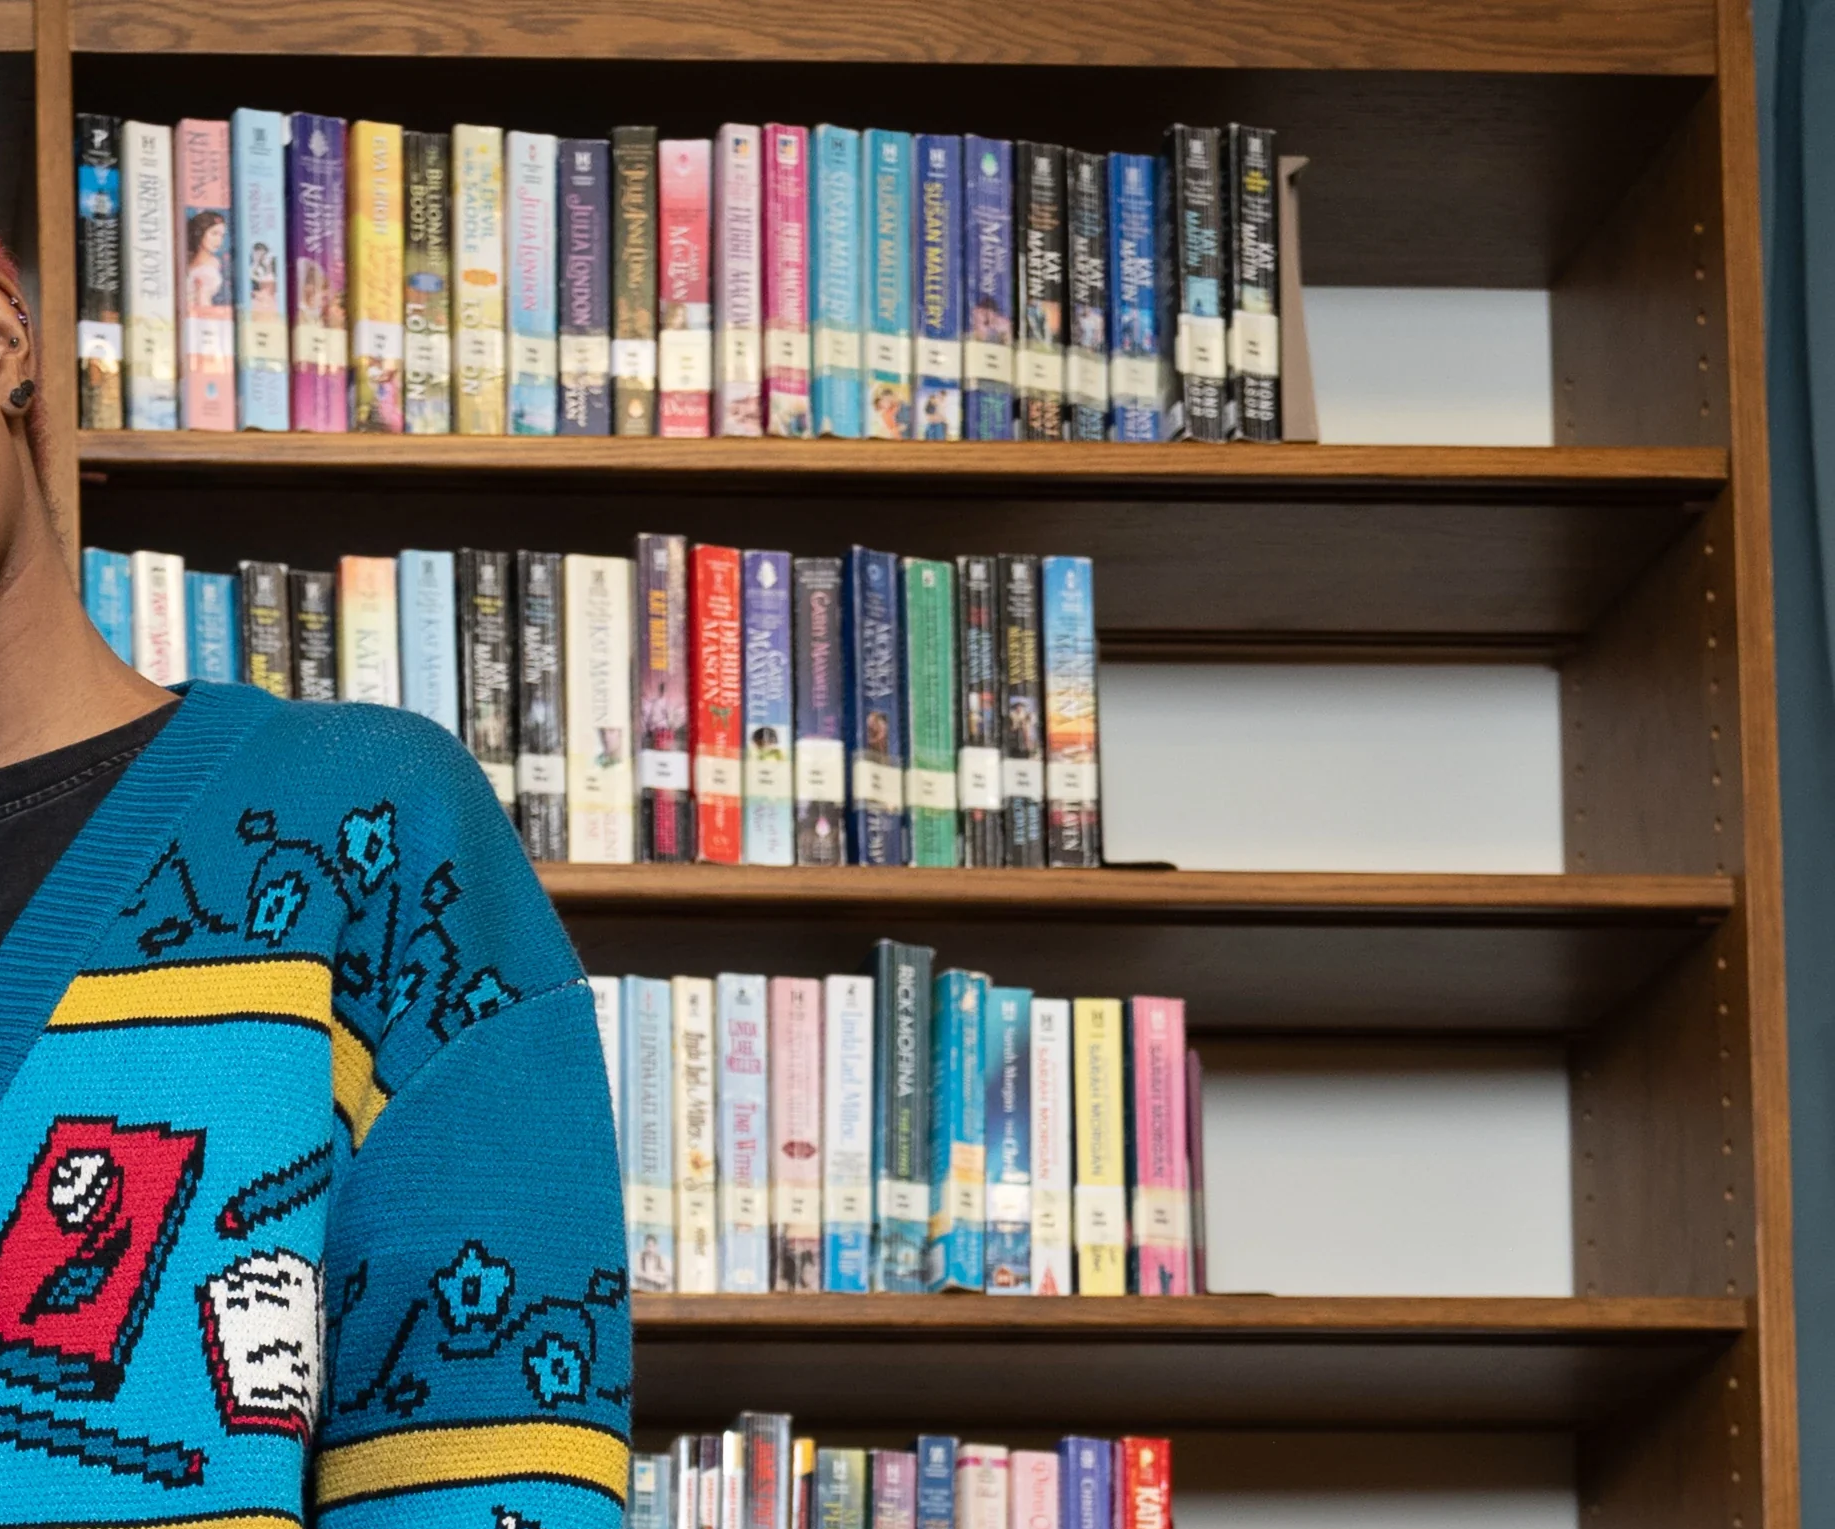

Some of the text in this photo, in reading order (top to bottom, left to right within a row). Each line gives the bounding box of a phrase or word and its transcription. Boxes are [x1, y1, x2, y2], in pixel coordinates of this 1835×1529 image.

[134, 173, 161, 299] BRENDA JOYCE
[921, 182, 942, 328] SUSAN MALLERY
[896, 964, 915, 1097] RICK MOFINA
